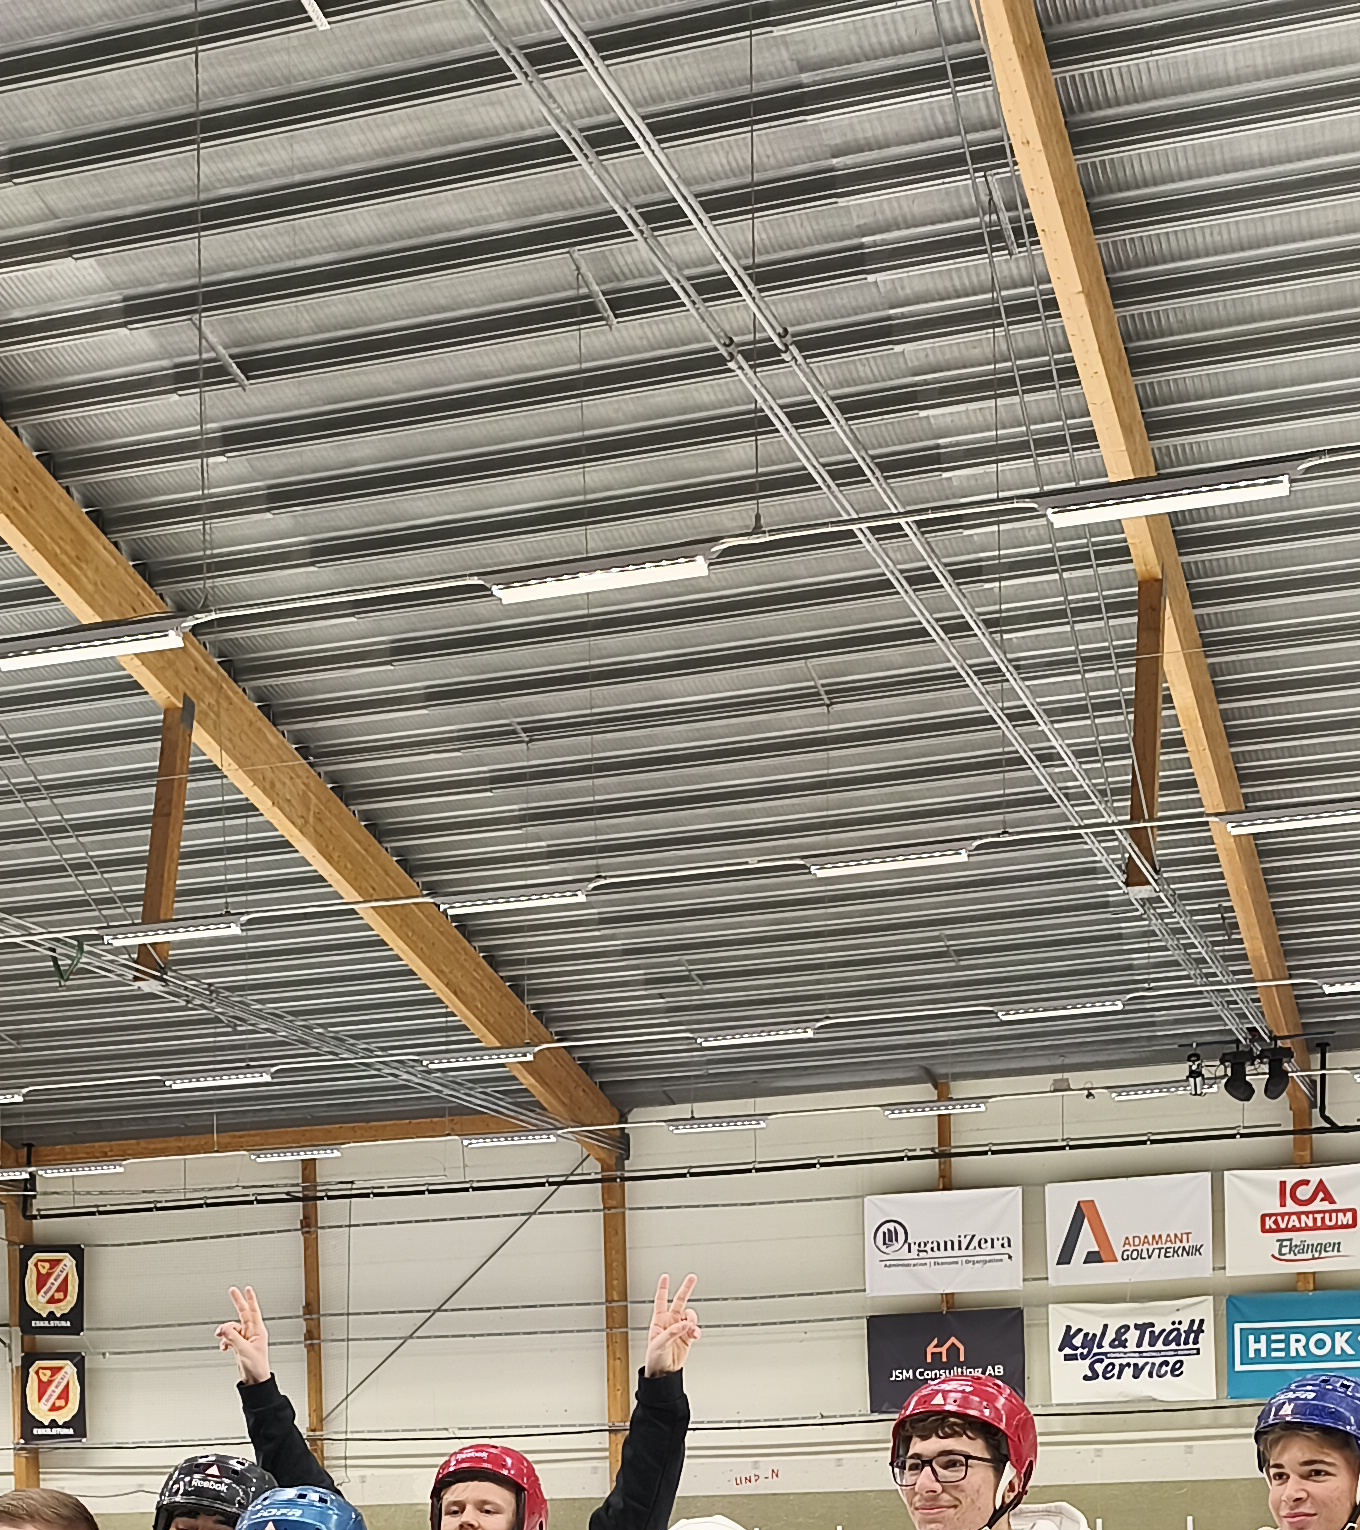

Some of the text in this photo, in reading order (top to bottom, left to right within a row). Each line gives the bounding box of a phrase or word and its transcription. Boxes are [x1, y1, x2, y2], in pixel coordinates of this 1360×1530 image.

[1279, 1177, 1337, 1209] ICA
[1264, 1210, 1354, 1230] KVANTUM
[1122, 1231, 1193, 1248] ADAMANT
[1275, 1237, 1342, 1259] Ekängen
[1120, 1243, 1204, 1261] GOLVTEKNIK
[1057, 1318, 1205, 1361] Kyl & Tvätt
[1247, 1330, 1357, 1359] HEROK
[889, 1368, 914, 1382] JSM
[984, 1364, 1004, 1377] AB
[1082, 1357, 1185, 1382] Service
[191, 1477, 228, 1493] Reebok
